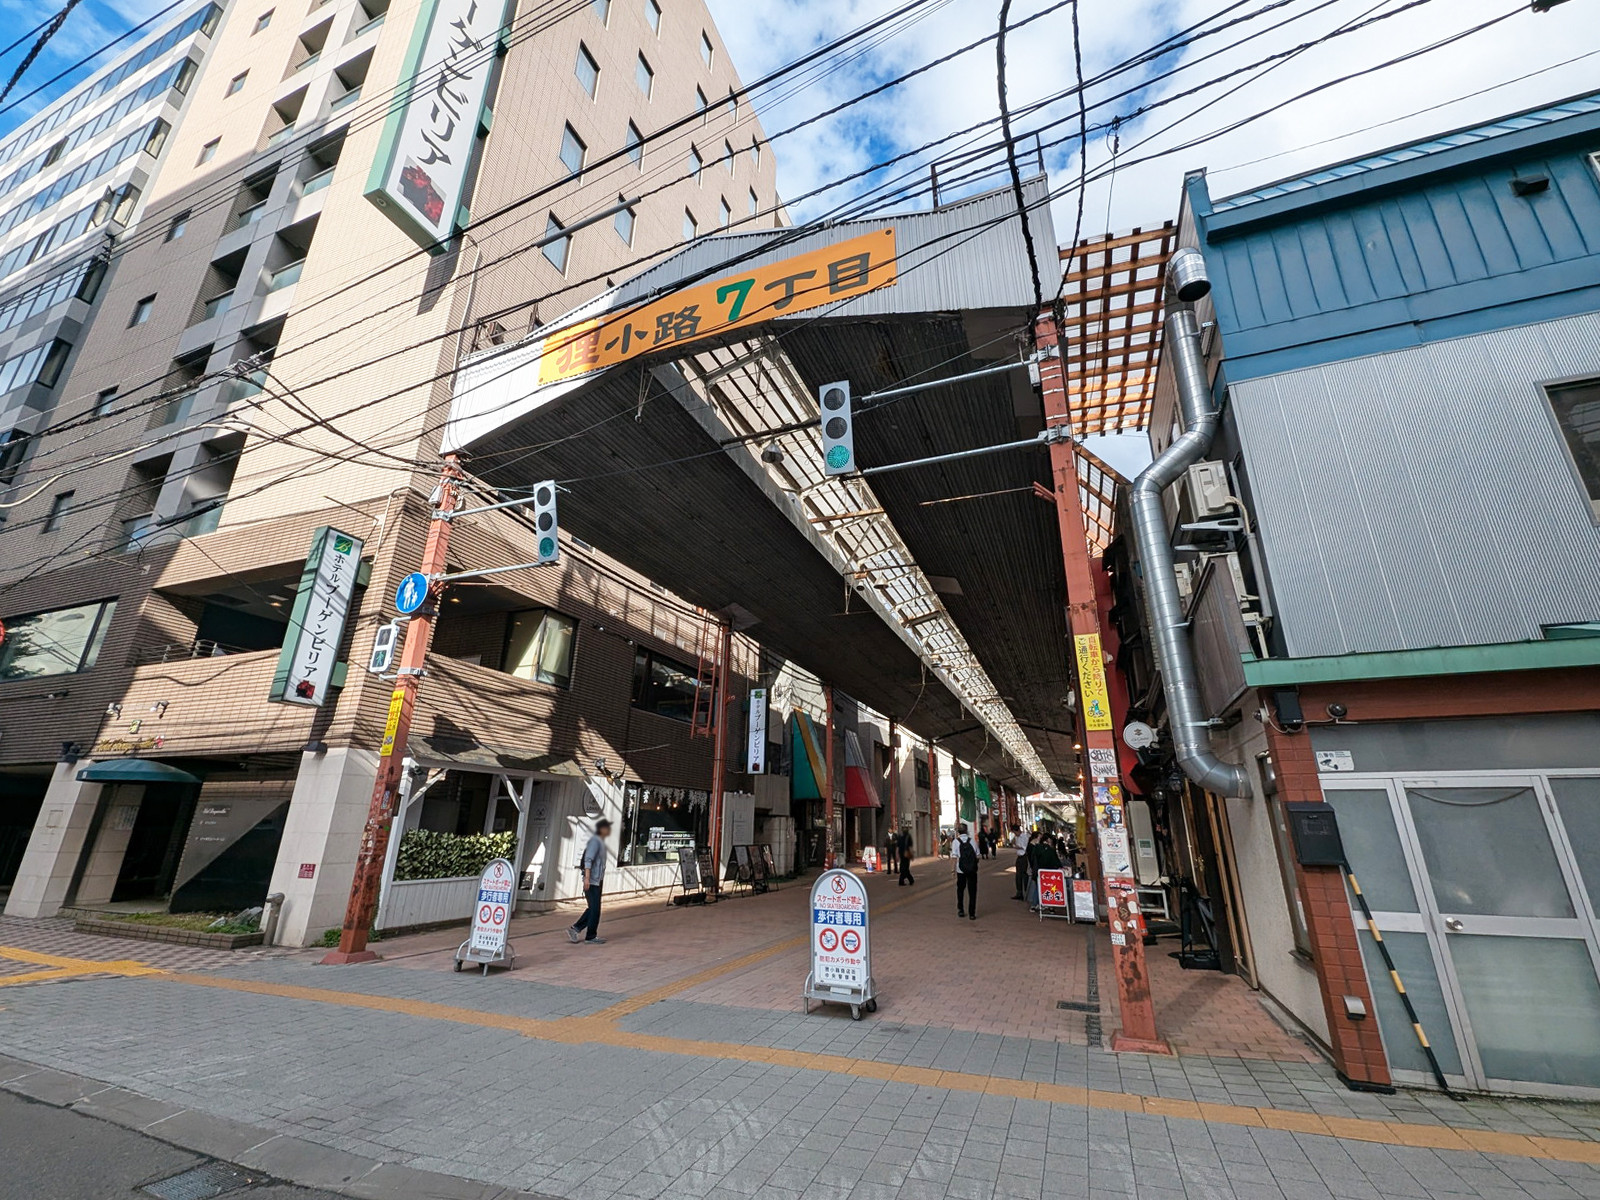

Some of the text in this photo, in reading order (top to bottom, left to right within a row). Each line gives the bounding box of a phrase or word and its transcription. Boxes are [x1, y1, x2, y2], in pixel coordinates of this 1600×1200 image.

[555, 252, 871, 376] 狸小路7丁目
[303, 554, 346, 678] ホテルブーゲンビリア
[1078, 637, 1094, 698] ご通行ください
[481, 891, 509, 903] 歩行者専用
[817, 894, 862, 905] スケートボード禁止
[818, 910, 862, 926] 歩行者専用
